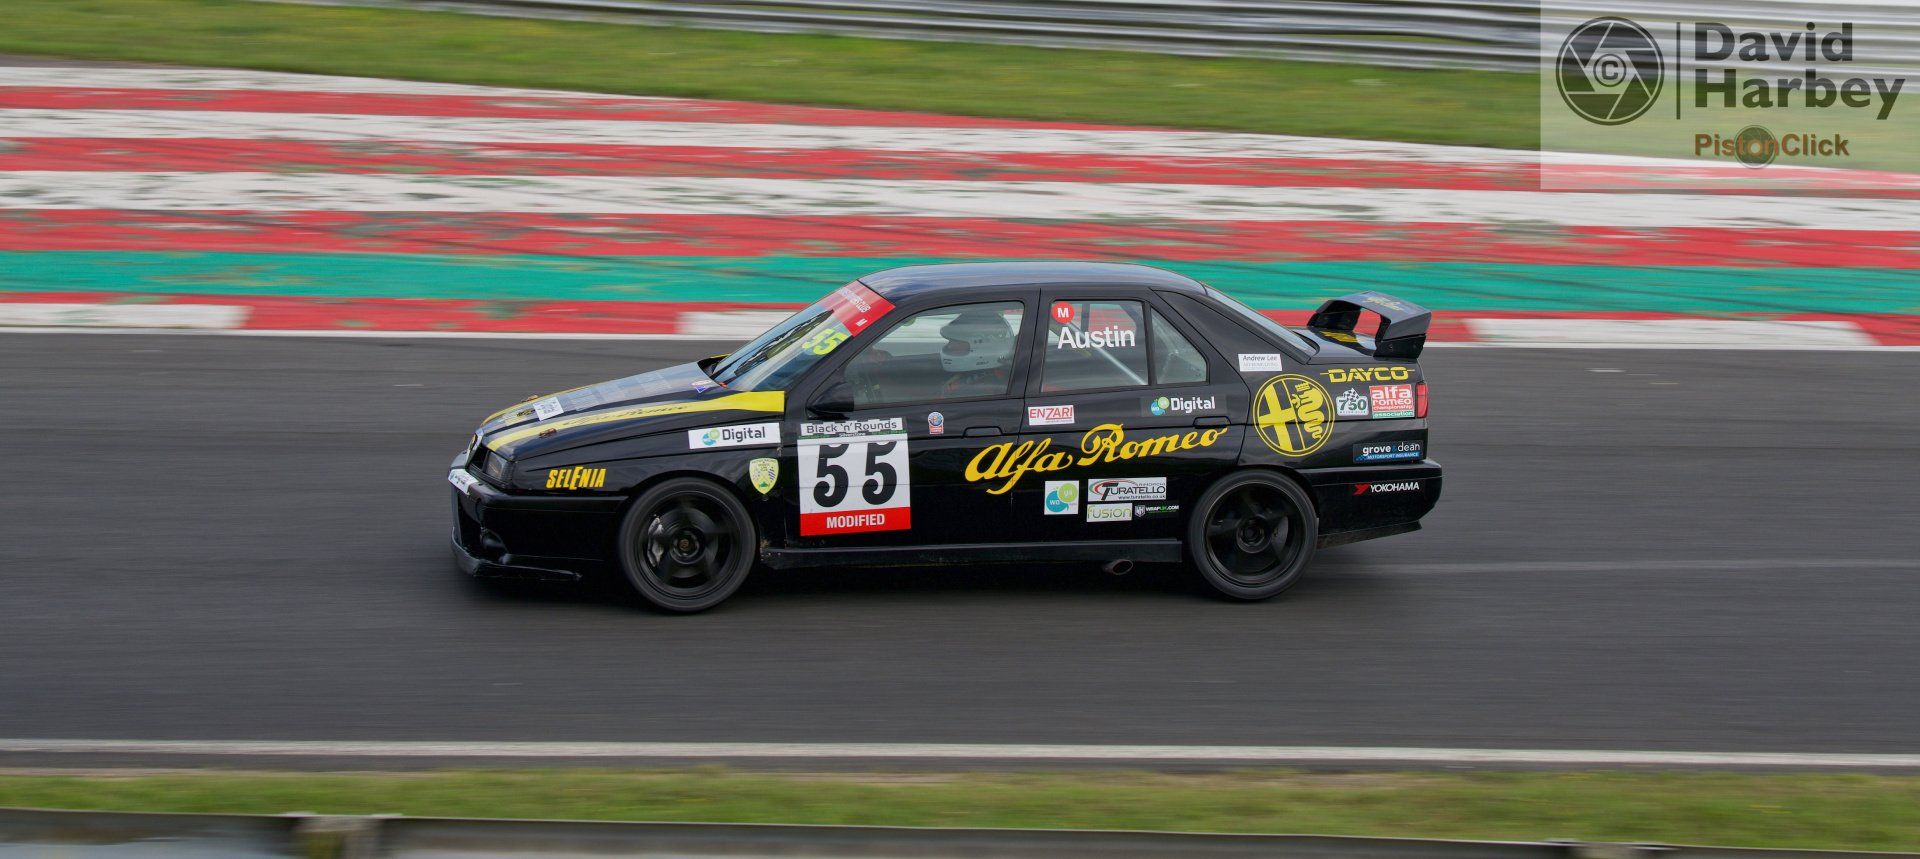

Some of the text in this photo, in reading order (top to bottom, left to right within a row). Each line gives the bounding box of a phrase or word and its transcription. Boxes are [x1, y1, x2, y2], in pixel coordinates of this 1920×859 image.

[1057, 307, 1070, 318] M
[802, 328, 849, 355] 55
[1057, 325, 1136, 349] Austin
[1328, 367, 1409, 382] DAYCO
[1371, 386, 1412, 399] alfa
[1170, 396, 1216, 413] Digital
[1338, 399, 1367, 411] 750
[1372, 398, 1412, 406] romeo
[1029, 407, 1073, 420] ENZARI
[1374, 410, 1414, 418] association
[806, 424, 838, 434] Black
[855, 420, 897, 430] Rounds
[722, 426, 766, 443] Digital
[1362, 445, 1391, 456] grove
[1397, 442, 1421, 452] dean
[965, 423, 1228, 495] Alfa Romeo
[545, 466, 607, 490] SELENIA
[813, 441, 898, 508] 55
[1100, 483, 1166, 500] TURATELLO
[1370, 482, 1420, 492] YOKOHAMA
[1087, 505, 1132, 518] fusion
[826, 513, 886, 529] MODIFIED
